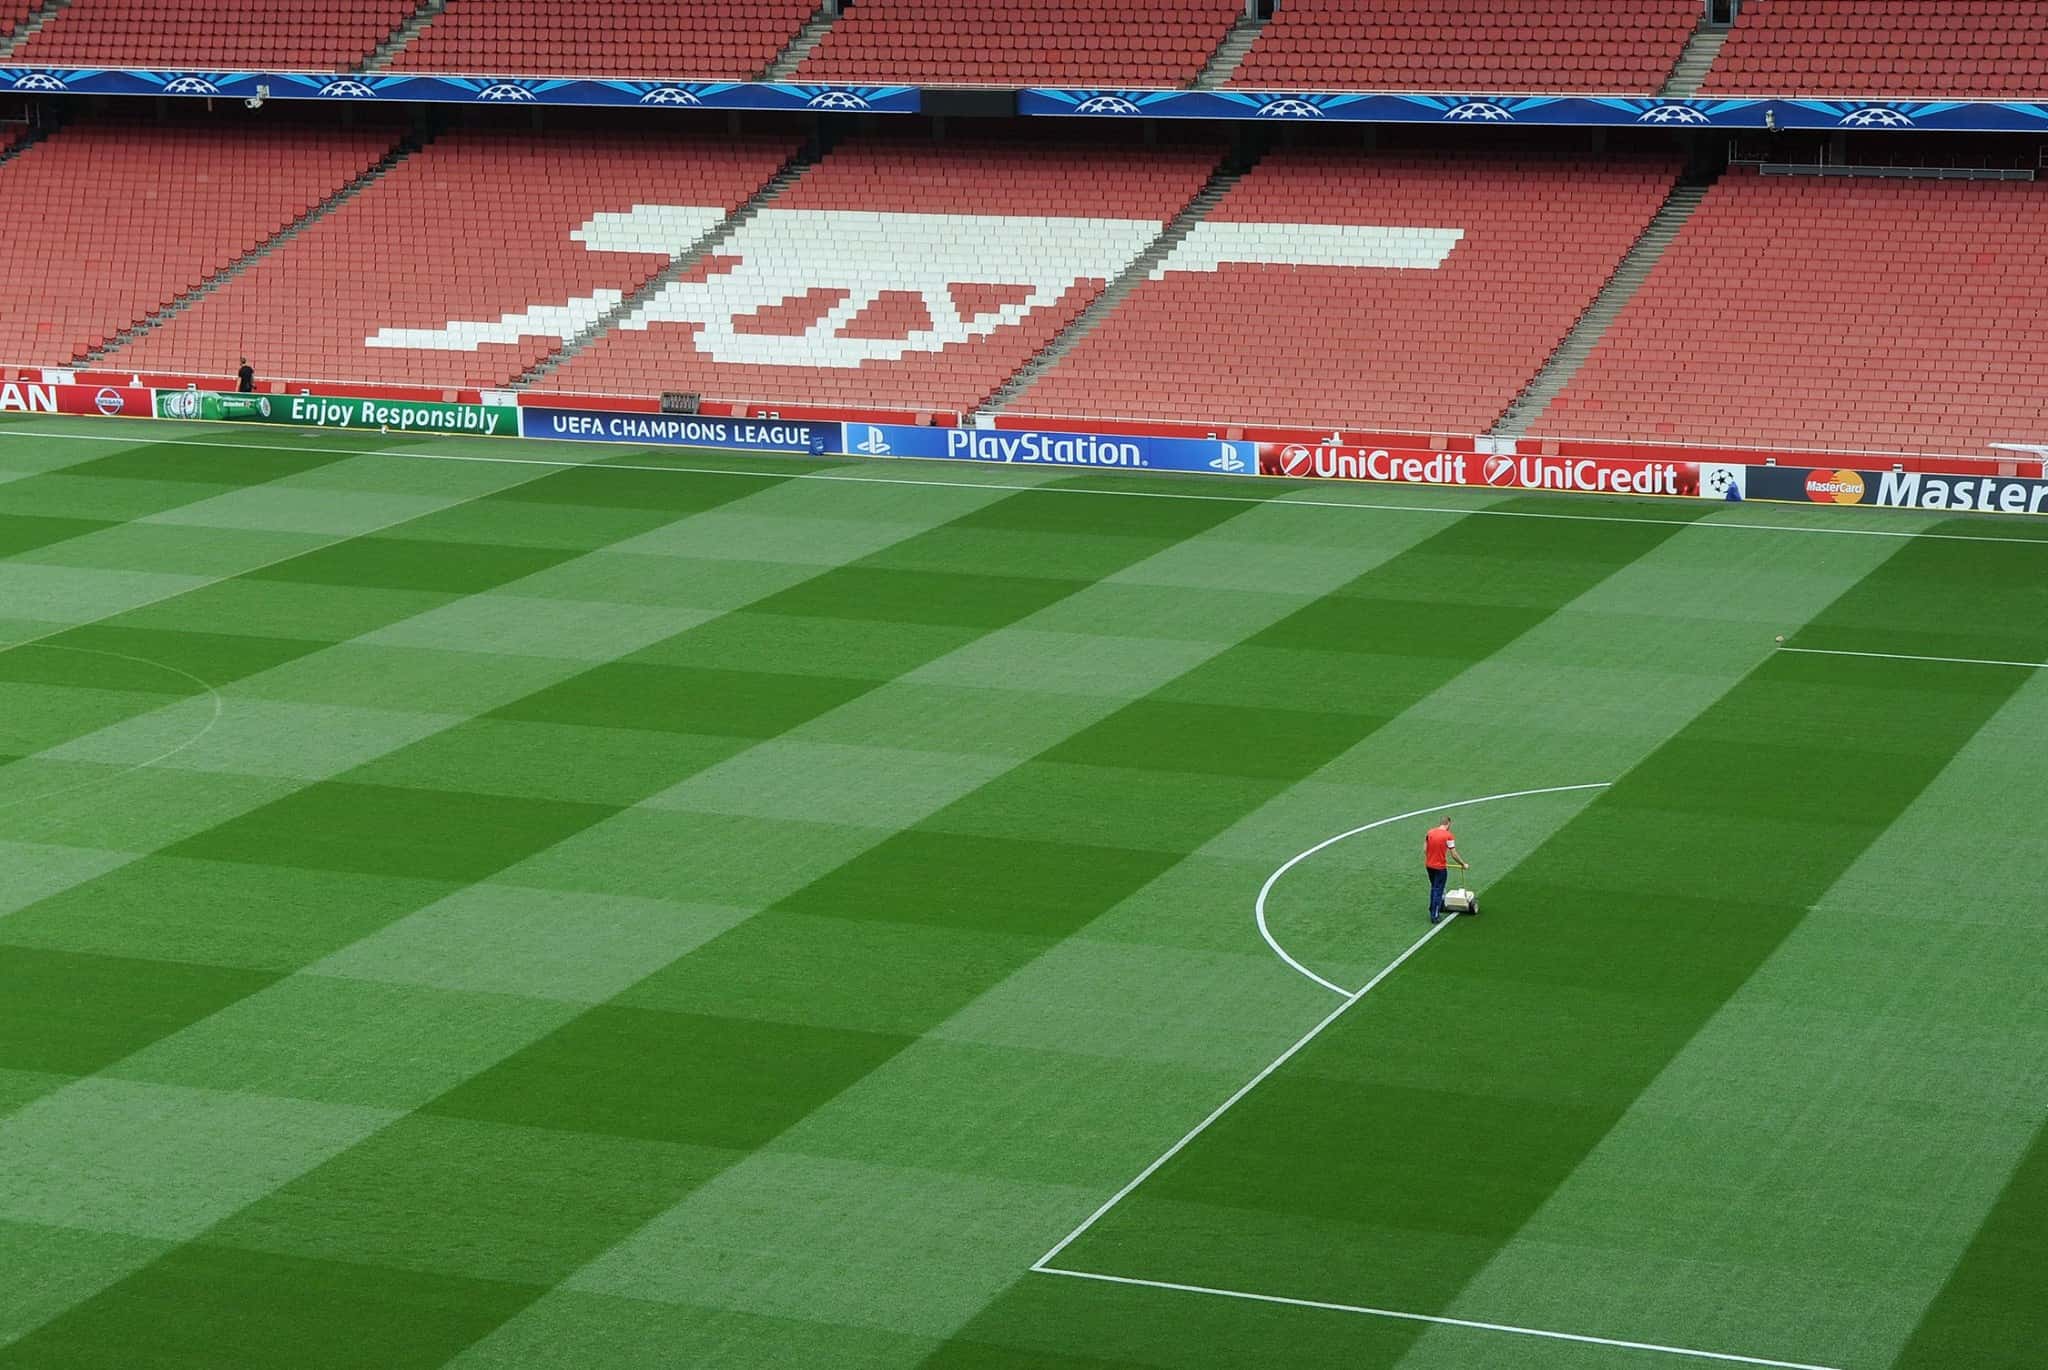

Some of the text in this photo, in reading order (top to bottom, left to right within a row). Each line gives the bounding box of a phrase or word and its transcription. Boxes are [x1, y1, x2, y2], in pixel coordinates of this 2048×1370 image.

[292, 398, 499, 434] Enjoy Responsibly
[553, 415, 810, 446] UEFA CHAMPIONS LEAGUE
[947, 430, 1140, 466] PlayStation
[1315, 447, 1466, 484] UniCredit
[1519, 457, 1678, 494] UniCredit
[1806, 480, 1863, 494] MasterCard
[1876, 472, 2047, 512] Master
